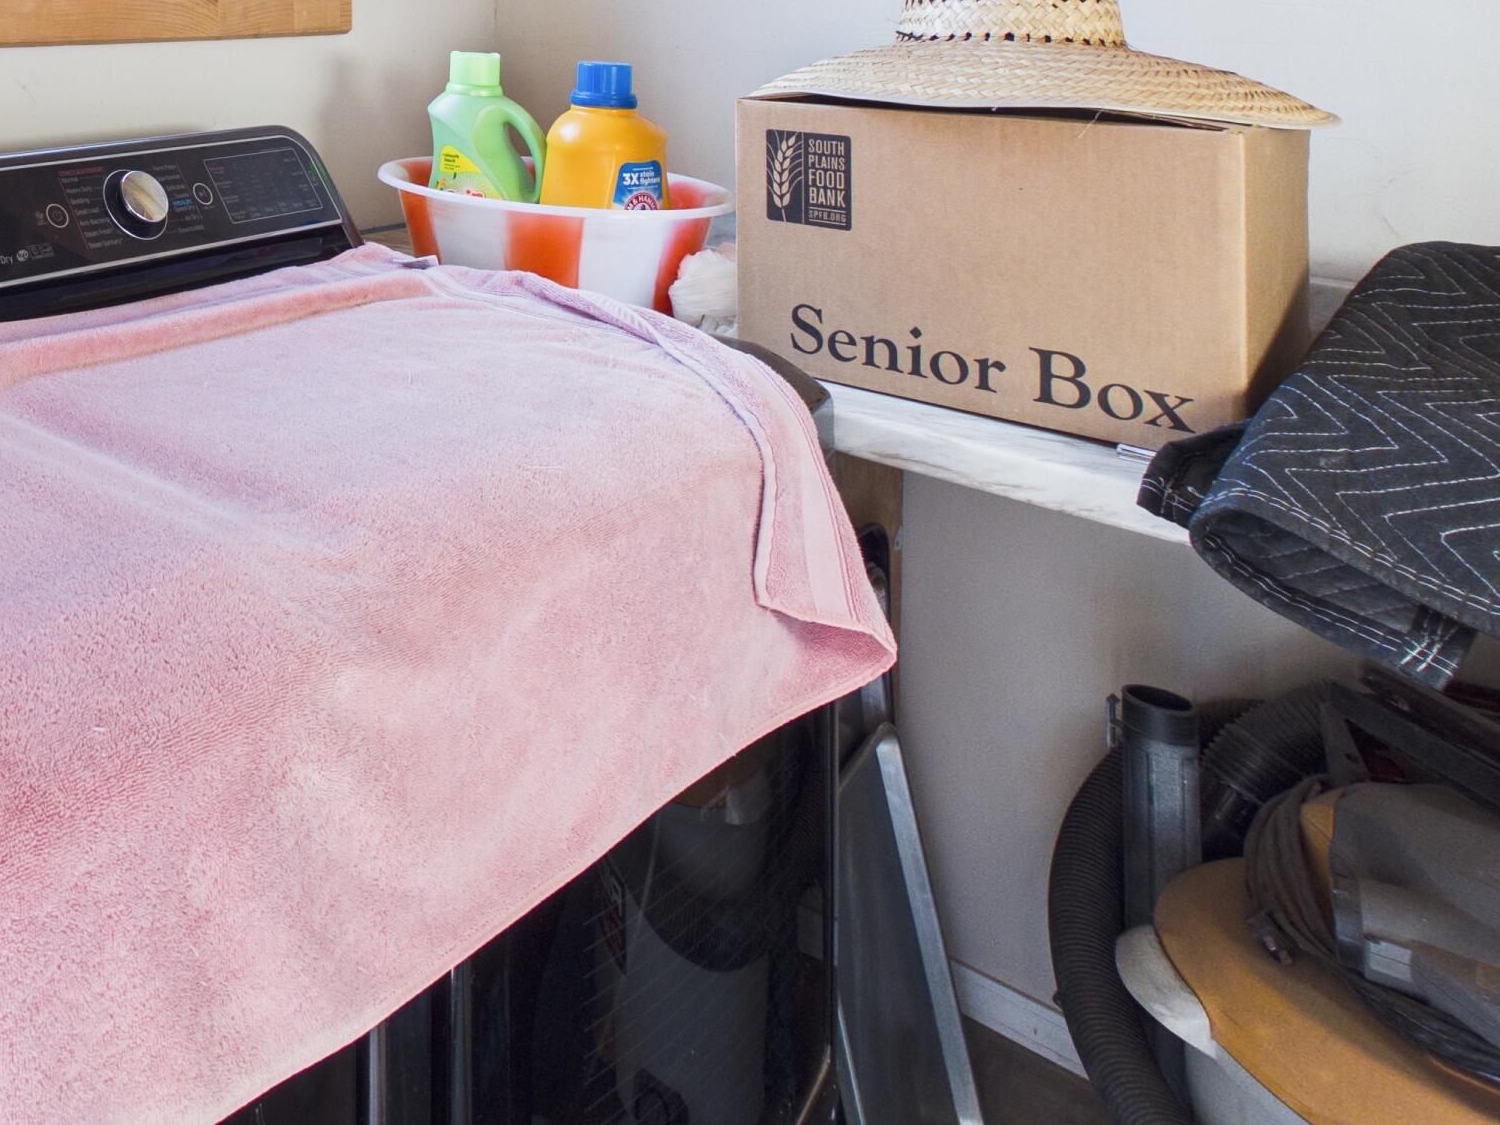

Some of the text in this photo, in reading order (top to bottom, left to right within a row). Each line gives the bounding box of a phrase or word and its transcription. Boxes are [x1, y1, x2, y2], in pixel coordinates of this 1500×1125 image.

[808, 138, 845, 156] SOUTH
[808, 155, 846, 171] PLAINS
[622, 172, 640, 186] 3X
[640, 170, 655, 178] stain
[808, 169, 846, 190] FOOD
[808, 187, 847, 208] BANK
[808, 210, 847, 223] SPFB.ORG
[0, 255, 14, 265] Dry
[789, 303, 1197, 434] Senior Box
